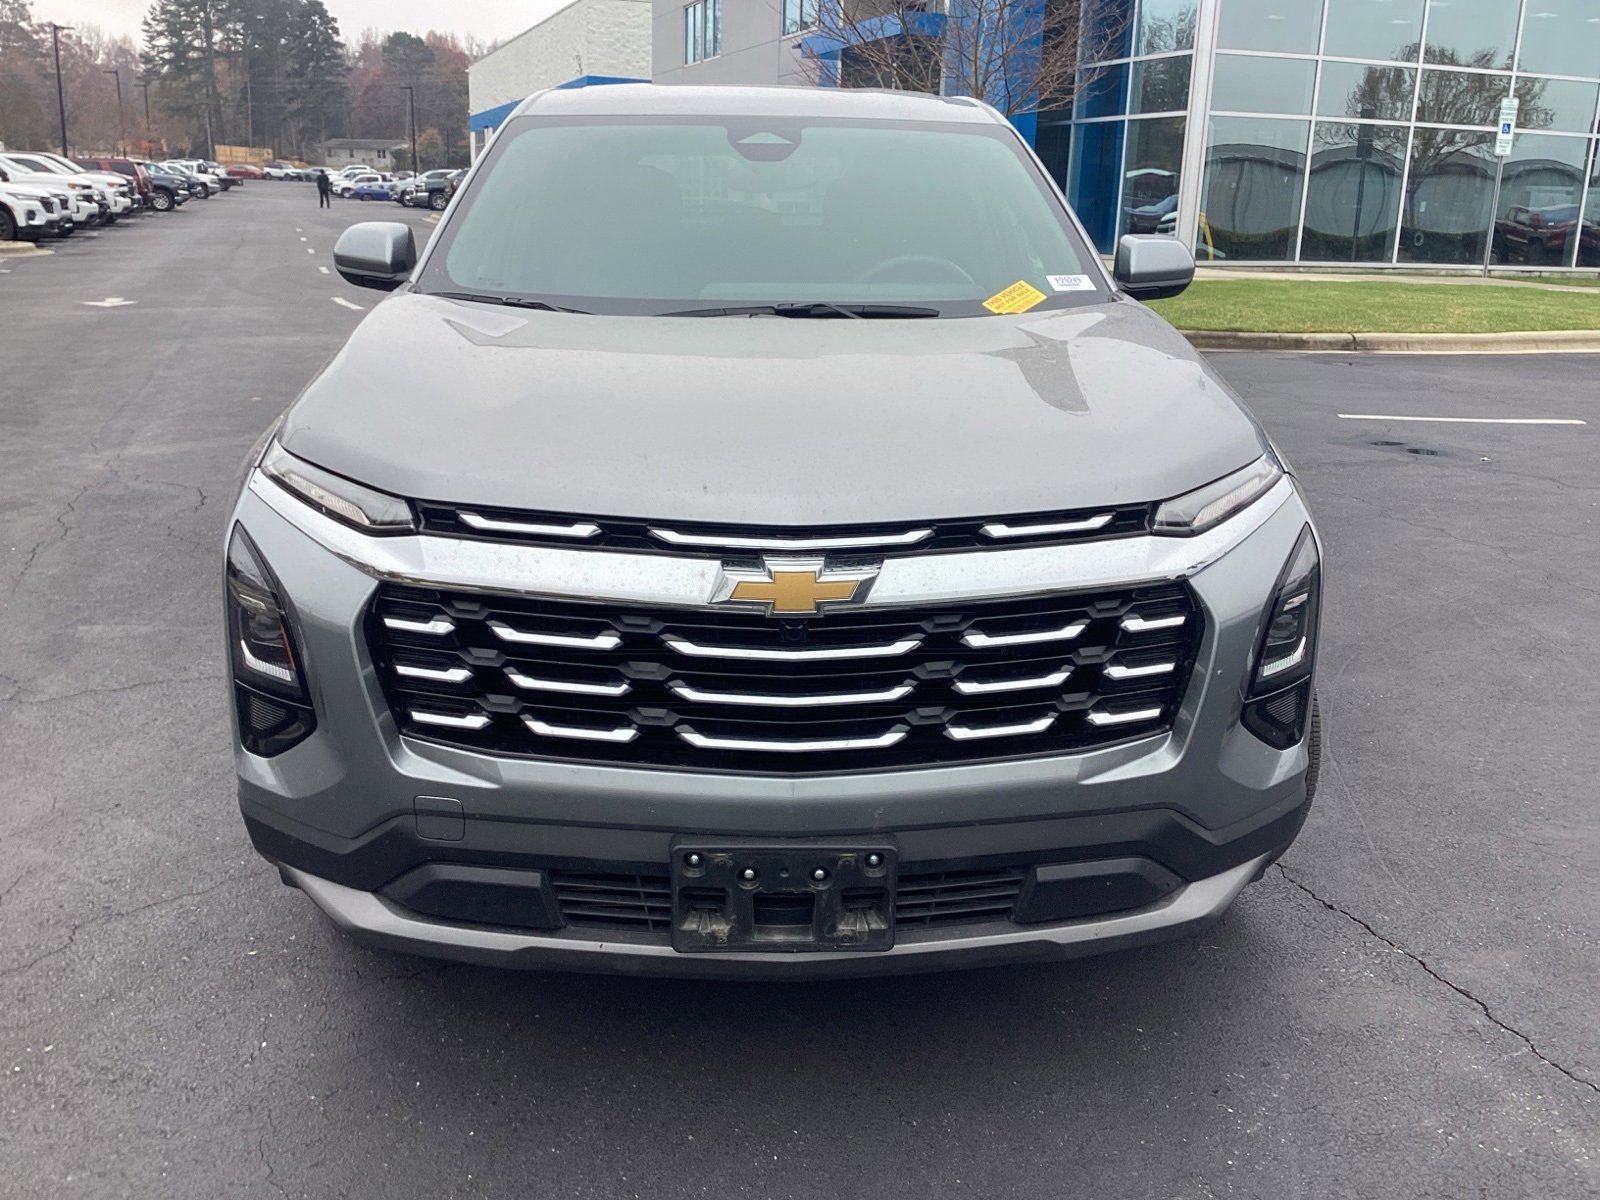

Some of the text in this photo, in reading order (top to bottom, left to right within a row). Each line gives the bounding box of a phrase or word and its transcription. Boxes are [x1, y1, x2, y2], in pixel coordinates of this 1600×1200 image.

[985, 296, 1002, 307] THIS
[1000, 282, 1026, 299] VEHICLE
[1016, 287, 1031, 298] SALE
